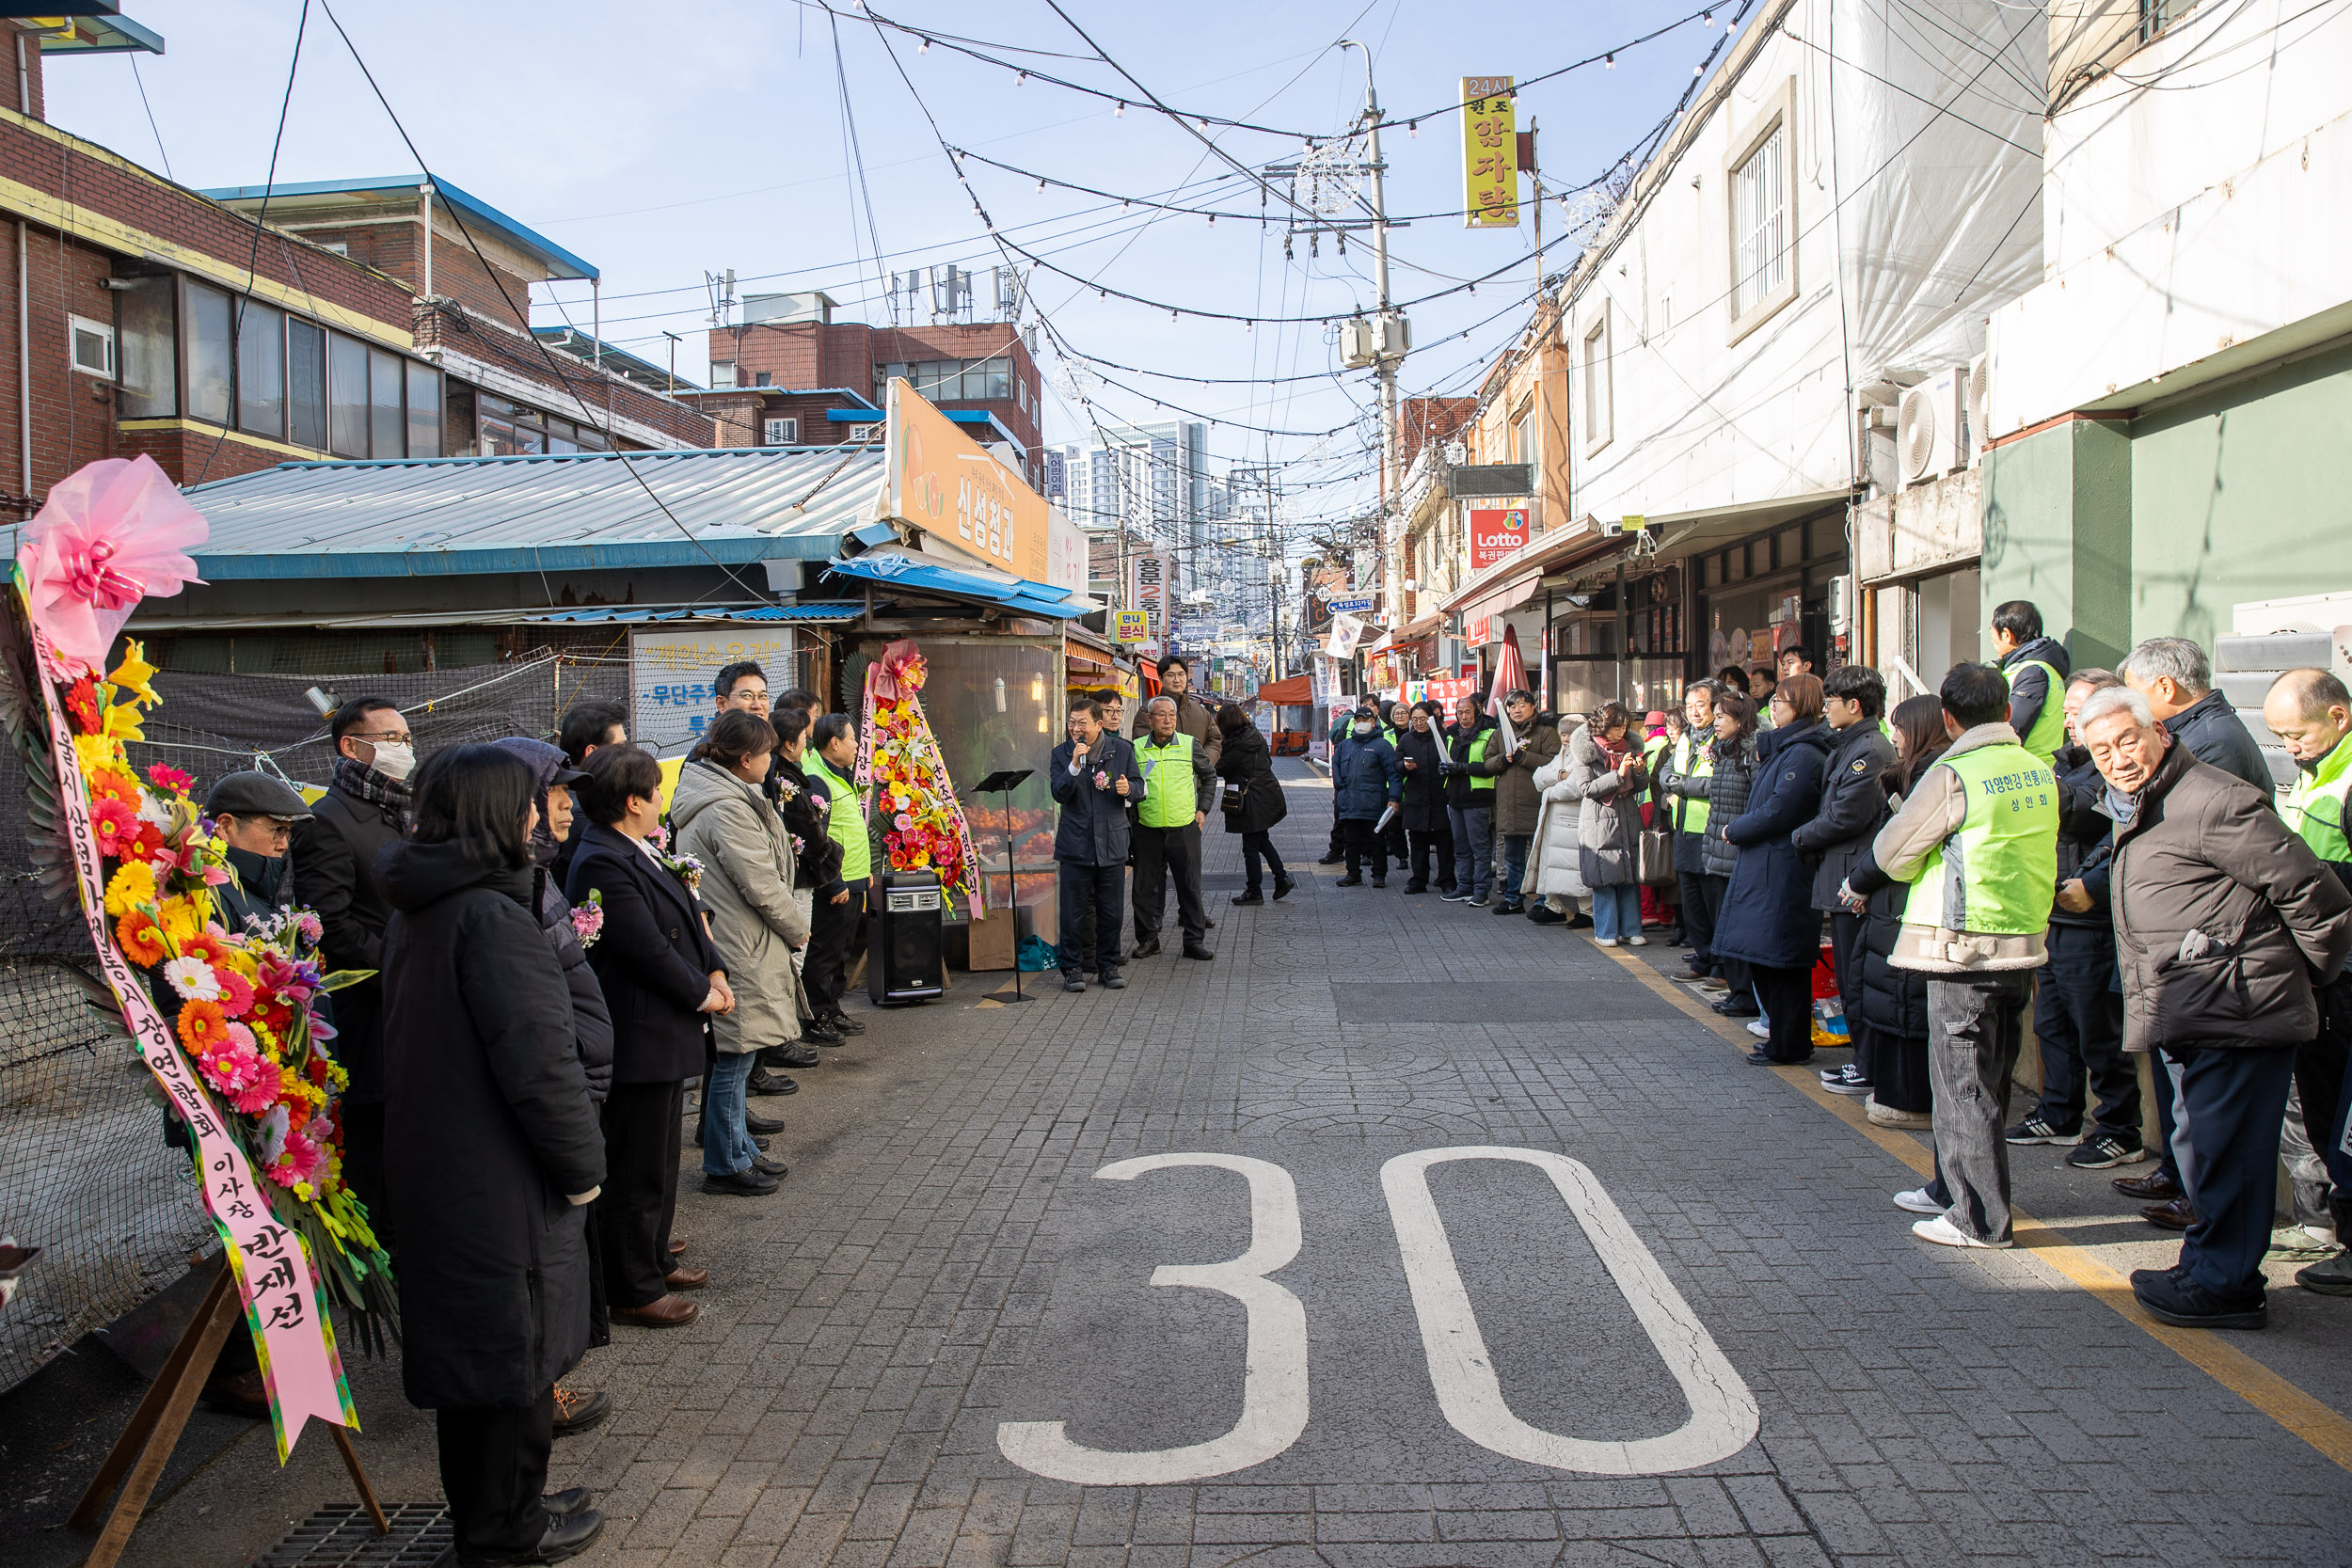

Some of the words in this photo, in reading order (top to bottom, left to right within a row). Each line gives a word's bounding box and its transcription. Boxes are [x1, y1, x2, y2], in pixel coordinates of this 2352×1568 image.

[1469, 78, 1509, 97] 24시
[1470, 101, 1509, 115] 원조
[1472, 116, 1514, 217] 감자탕
[1050, 459, 1061, 492] 어린이집
[957, 475, 1014, 564] 신성청과
[1477, 532, 1522, 546] Lotto
[1119, 625, 1145, 639] 분식
[1122, 614, 1140, 624] 만나
[1982, 772, 2023, 796] 자양한강
[2023, 769, 2054, 788] 전통시장
[214, 1152, 254, 1219] 이사장
[240, 1226, 305, 1330] 반재선
[997, 1146, 1760, 1485] 30
